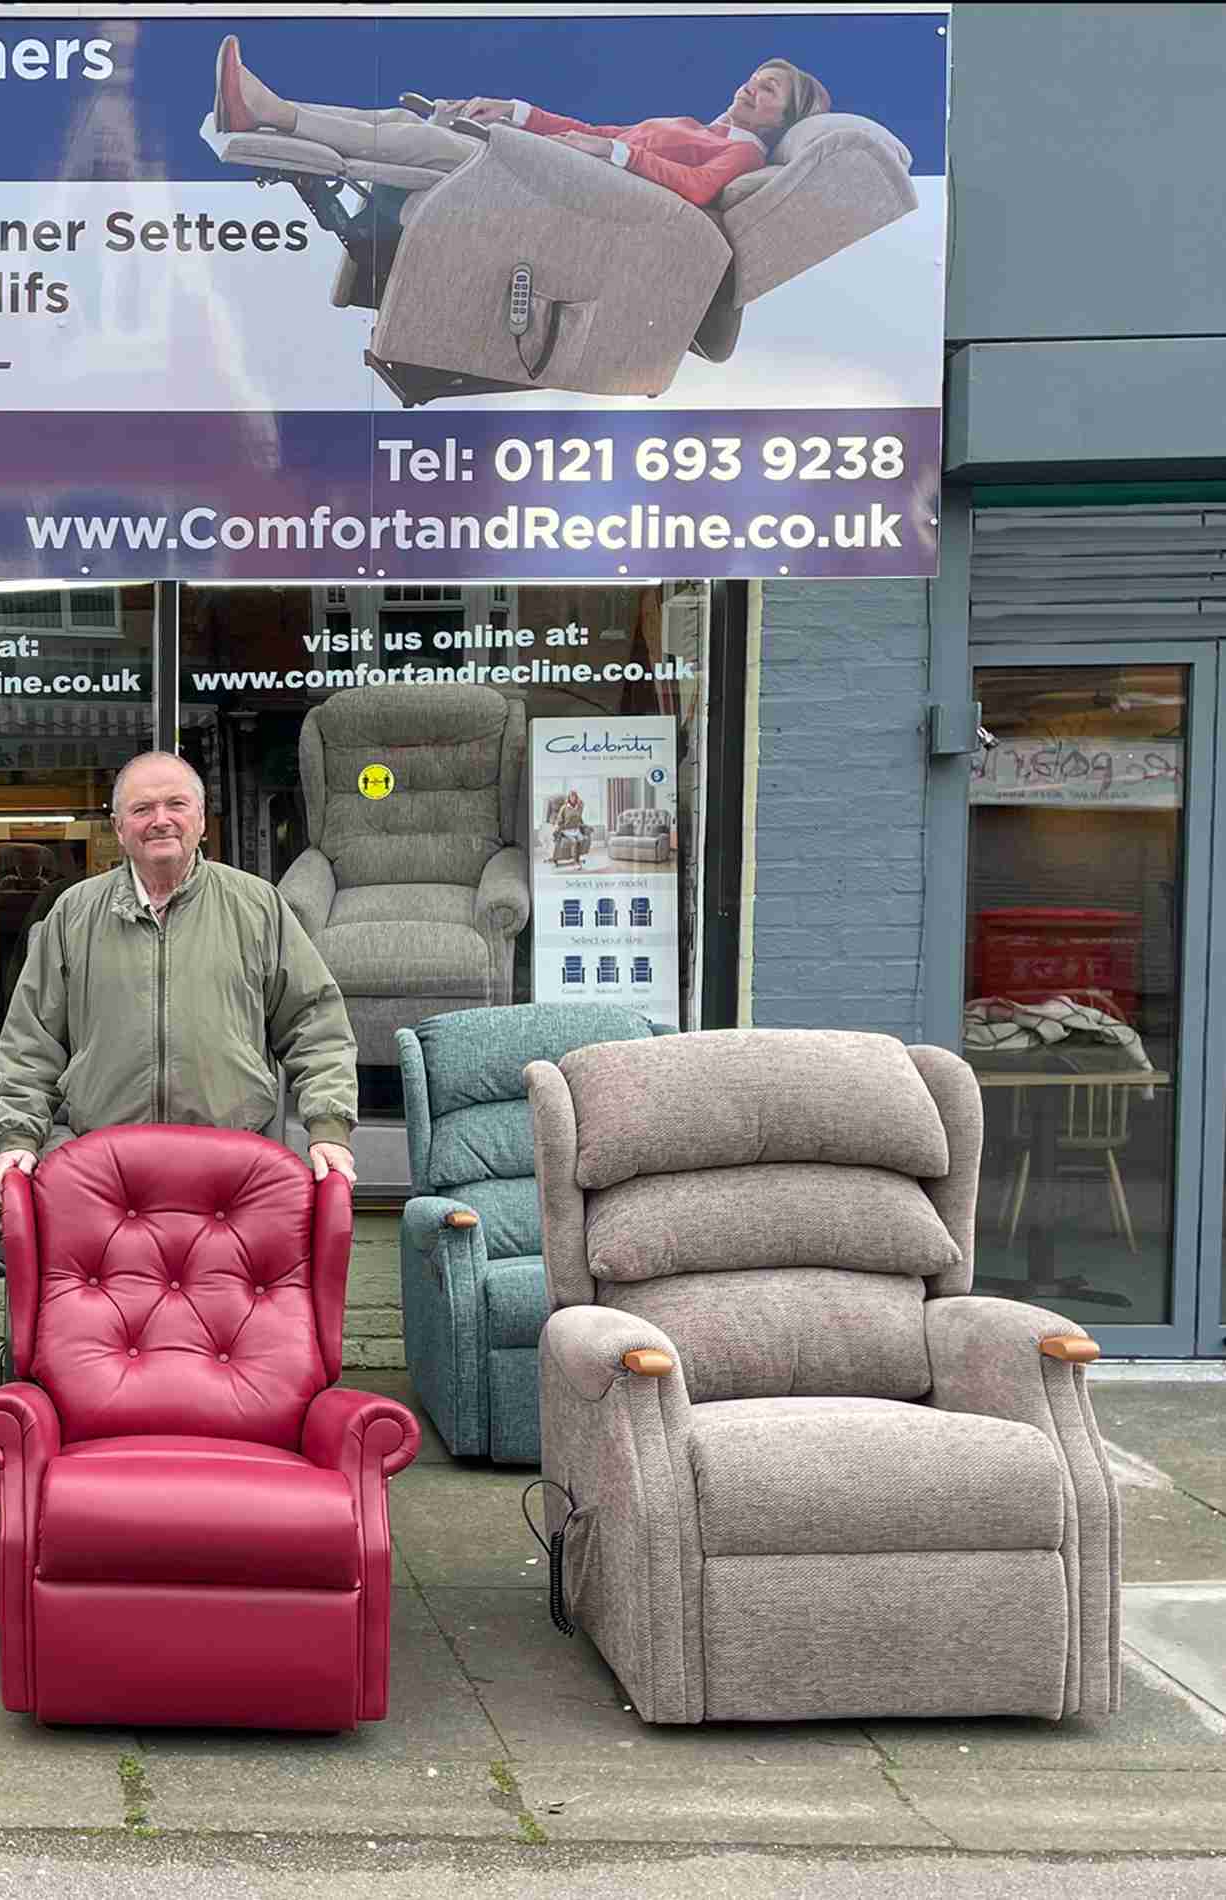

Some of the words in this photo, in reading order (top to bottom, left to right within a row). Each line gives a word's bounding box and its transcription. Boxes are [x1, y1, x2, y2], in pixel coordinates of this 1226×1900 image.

[105, 210, 308, 252] Settees
[378, 438, 473, 482] Tel:
[494, 438, 613, 482] 0121
[635, 437, 742, 481] 693
[762, 436, 904, 481] 9238
[25, 503, 902, 551] www.ComfortandRecline.co.uk
[302, 628, 373, 653] visit
[384, 631, 423, 651] us
[432, 623, 535, 650] online
[545, 622, 589, 647] at:
[192, 656, 695, 692] www.comfortandrecline.co.uk
[545, 732, 667, 760] Celebrity
